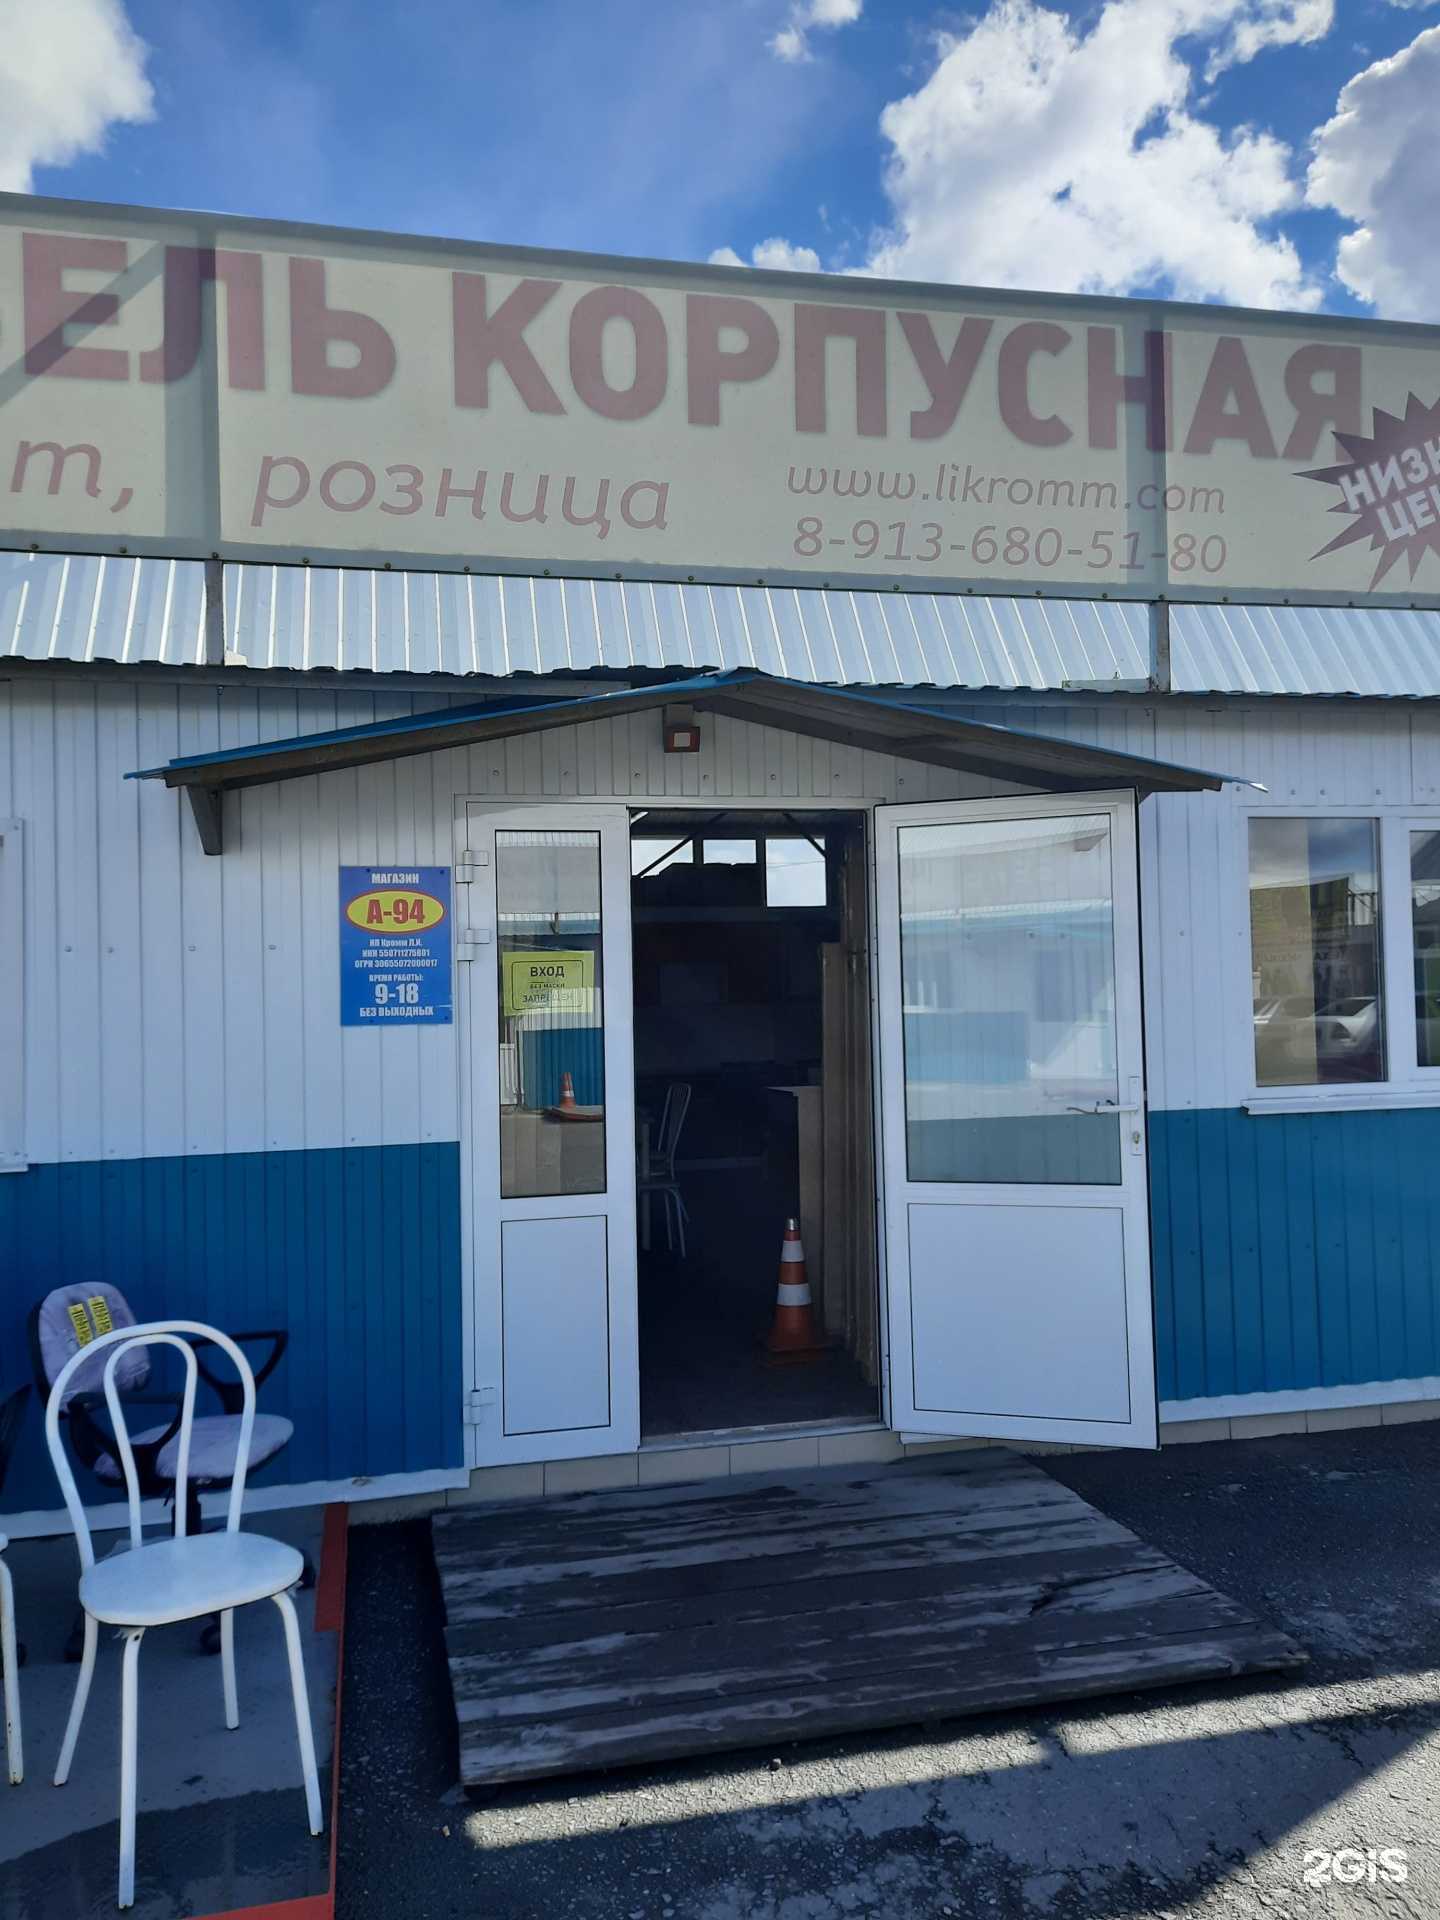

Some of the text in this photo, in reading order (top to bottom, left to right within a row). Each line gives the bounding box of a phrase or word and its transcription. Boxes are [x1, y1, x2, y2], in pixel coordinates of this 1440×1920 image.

[0, 231, 1362, 462] ЕЛЬ КОРПУСНАЯ
[250, 454, 670, 539] розница
[787, 463, 1225, 514] www.likromm.com
[793, 516, 1227, 573] 8-913-680-51-80
[371, 873, 419, 884] МАГАЗИН
[366, 898, 426, 925] А-94
[369, 974, 392, 982] ВРЕМЯ
[530, 966, 565, 978] ВХОД
[374, 982, 419, 1005] 9-18
[359, 1006, 434, 1017] БЕЗ ВЫХОДНЫХ
